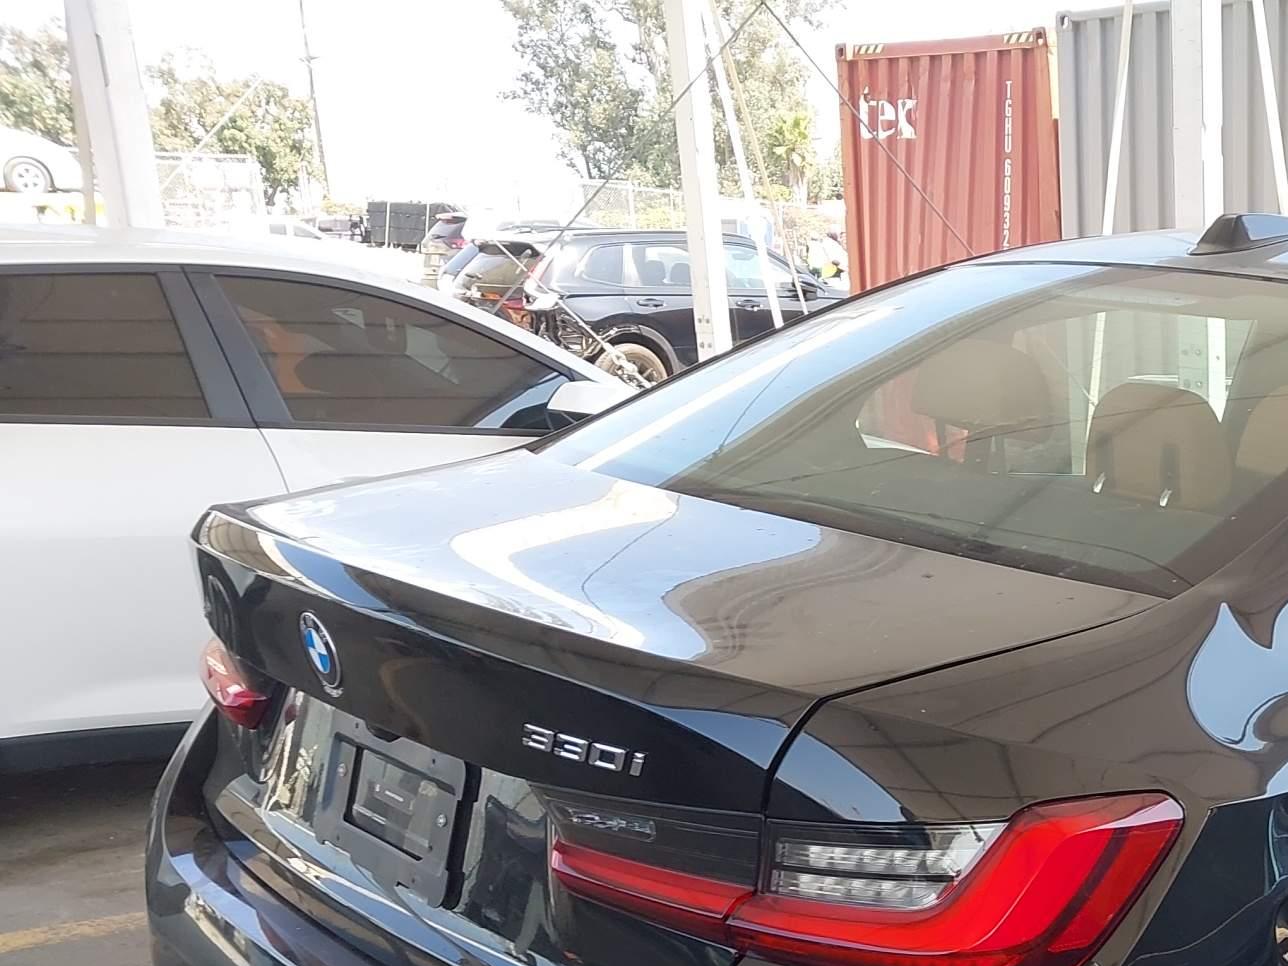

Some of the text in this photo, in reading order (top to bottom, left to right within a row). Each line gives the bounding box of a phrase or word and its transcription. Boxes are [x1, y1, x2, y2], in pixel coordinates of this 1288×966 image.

[1002, 80, 1013, 250] TGHU 60932
[521, 722, 648, 778] 330i
